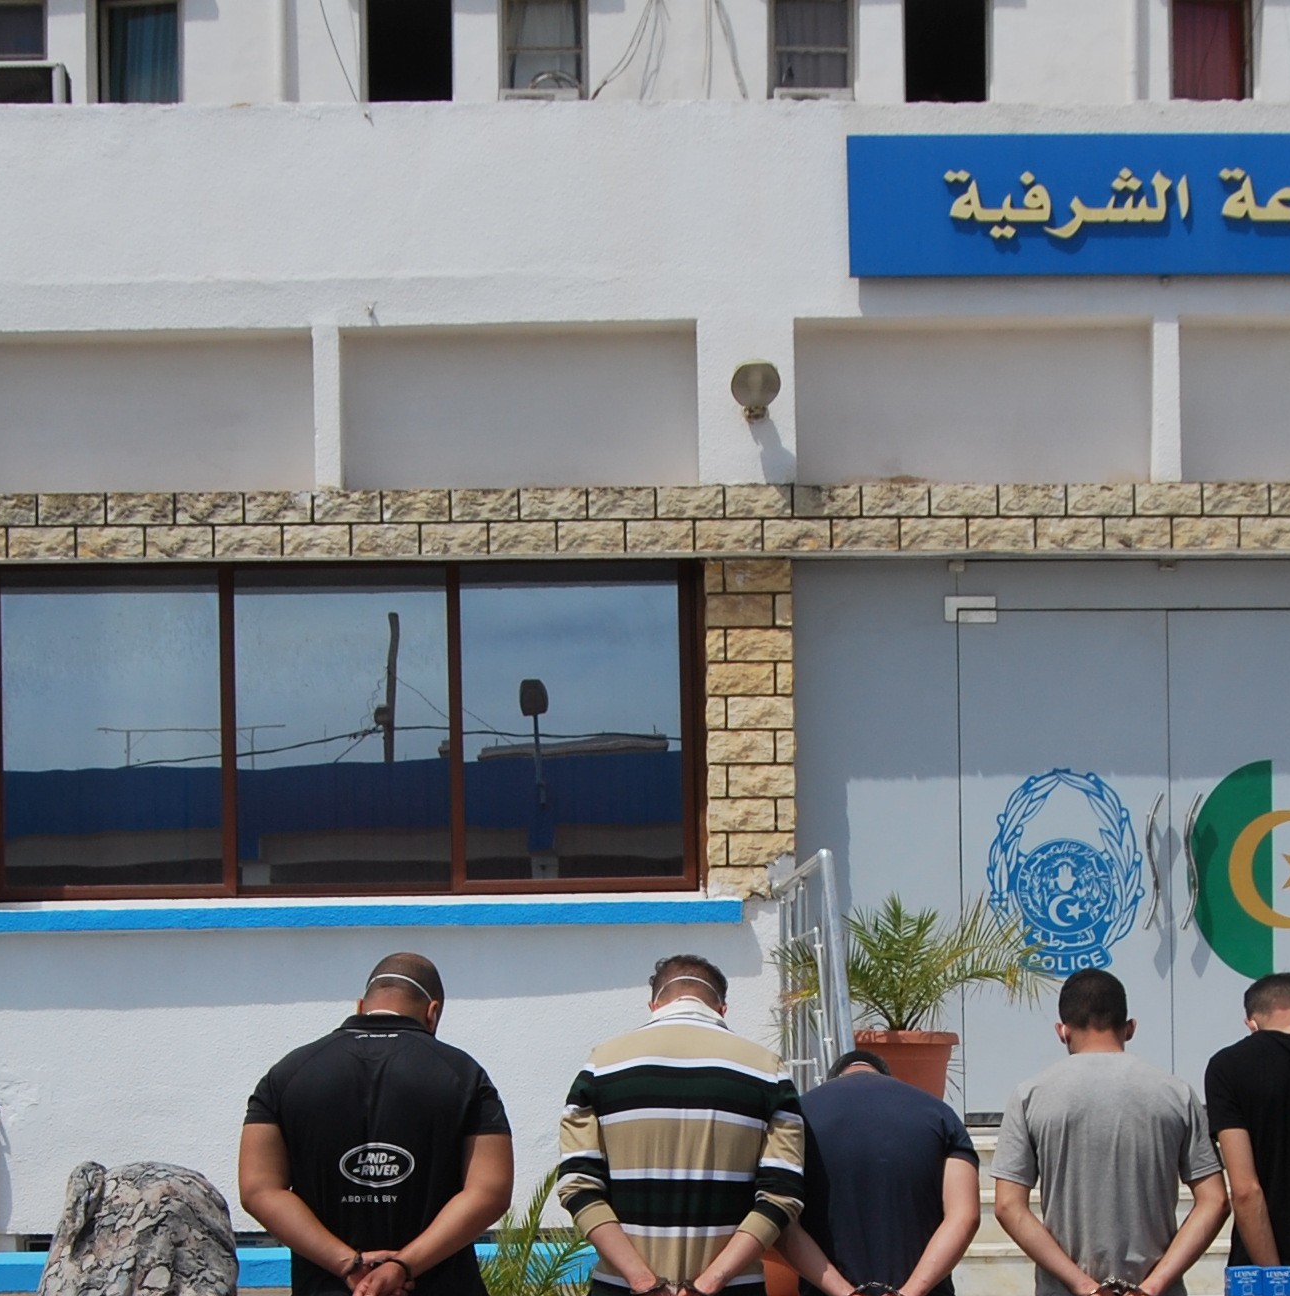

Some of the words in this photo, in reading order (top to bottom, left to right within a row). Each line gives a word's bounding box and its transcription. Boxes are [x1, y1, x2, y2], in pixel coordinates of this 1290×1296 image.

[943, 167, 1189, 239] الشرفية
[1028, 950, 1105, 971] POLICE
[357, 1152, 388, 1164] LAND
[361, 1164, 400, 1176] ROVER
